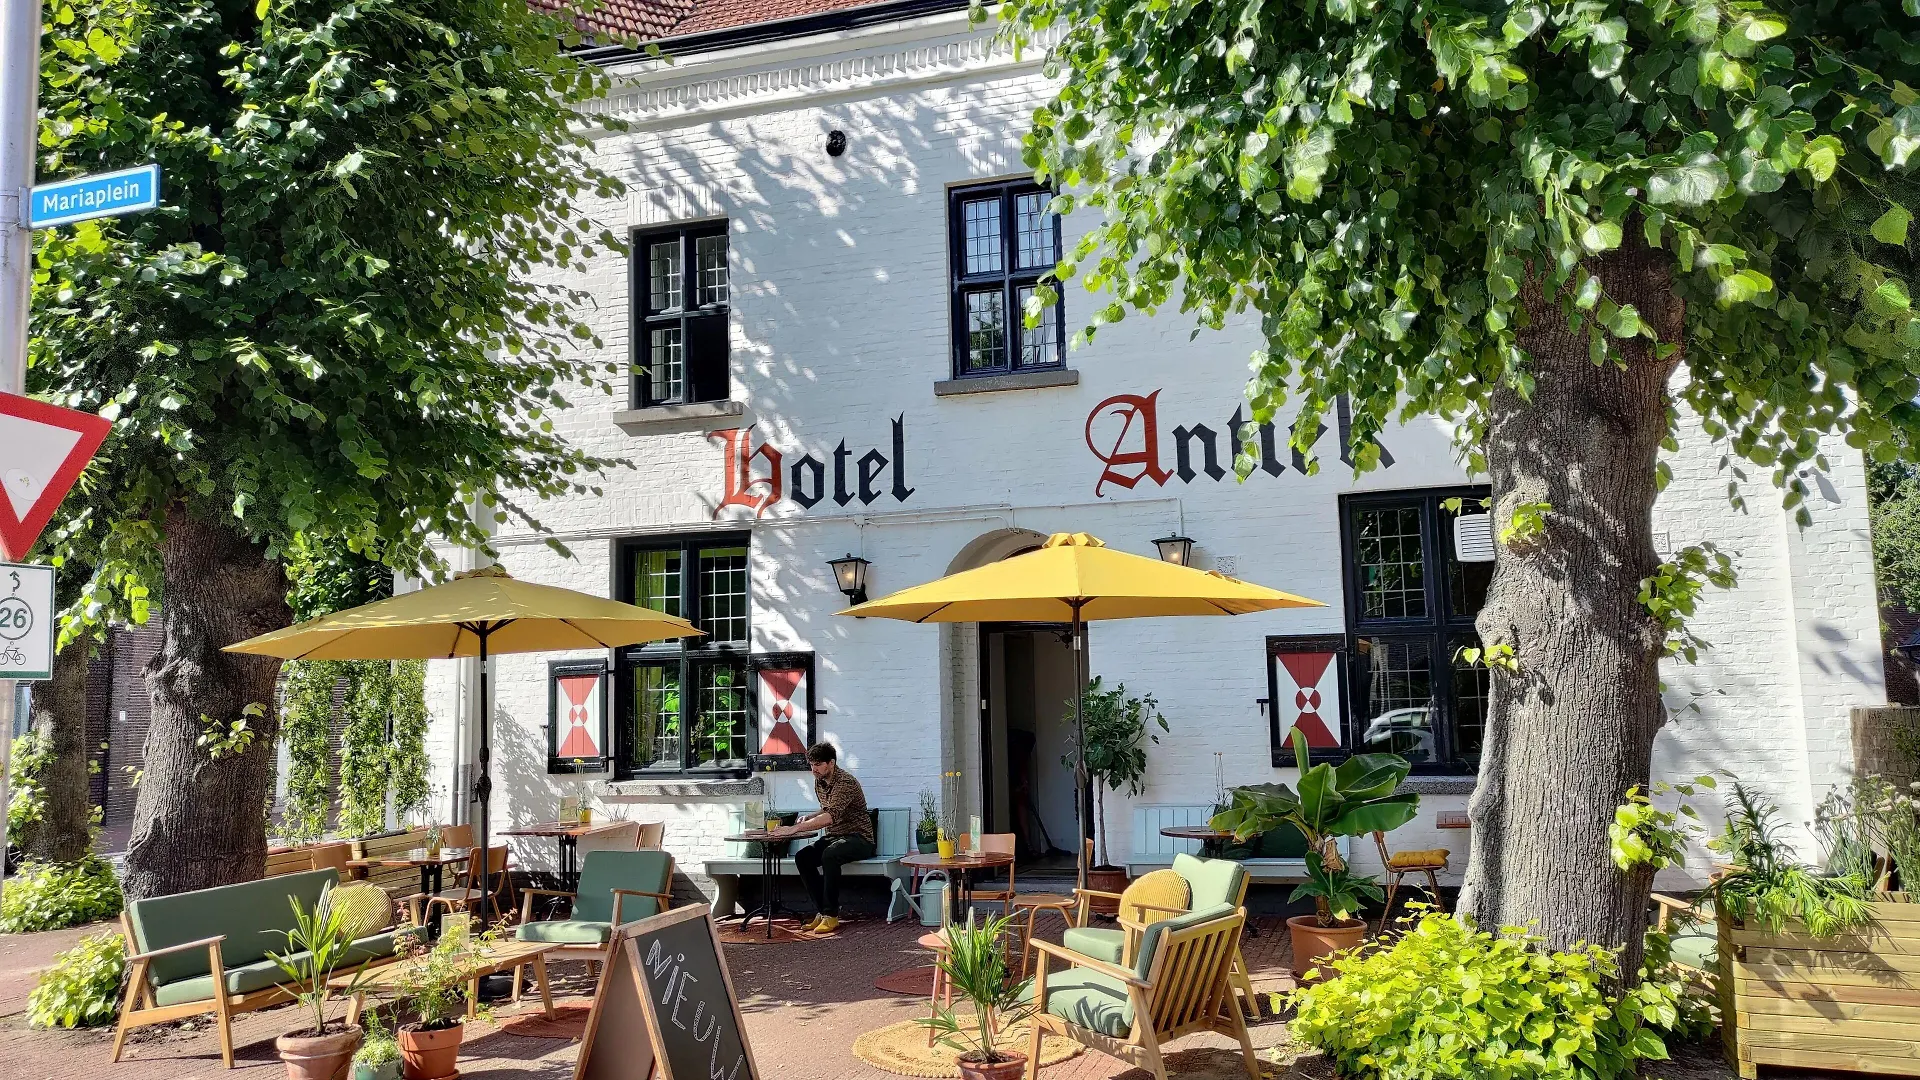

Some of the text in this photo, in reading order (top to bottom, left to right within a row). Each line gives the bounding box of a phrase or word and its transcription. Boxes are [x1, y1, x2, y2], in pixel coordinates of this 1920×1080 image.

[43, 180, 140, 213] Mariaplein
[707, 411, 915, 519] Hotel
[0, 607, 27, 628] 26
